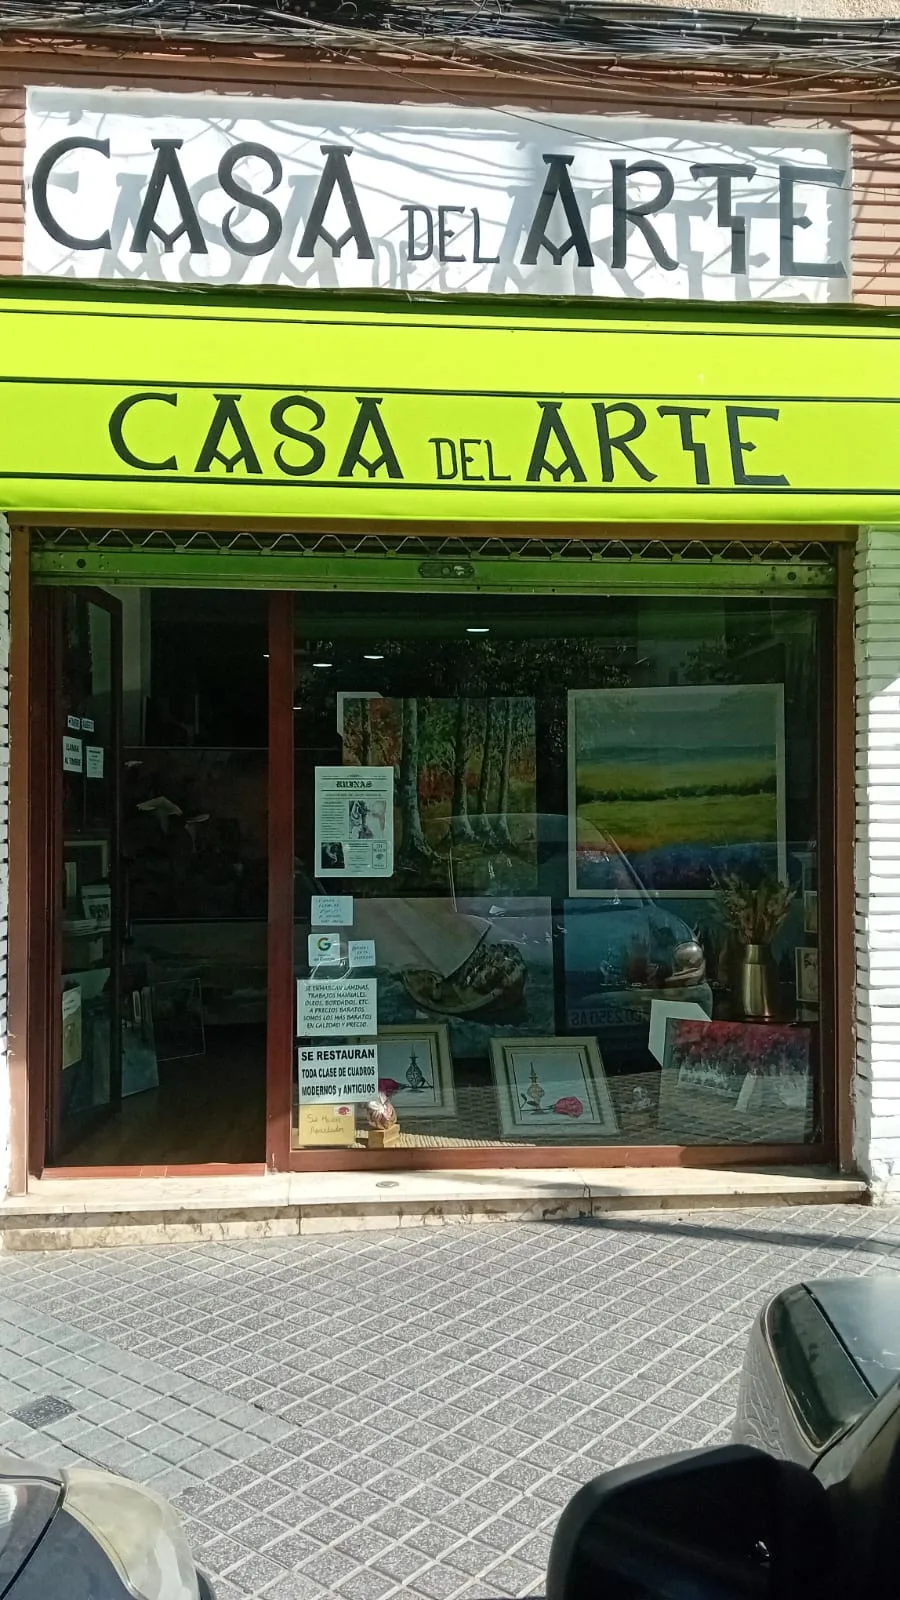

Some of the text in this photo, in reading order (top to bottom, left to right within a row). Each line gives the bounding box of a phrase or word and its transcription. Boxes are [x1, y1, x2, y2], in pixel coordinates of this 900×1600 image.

[32, 136, 848, 279] CASA DEL ARTE
[108, 392, 790, 486] CASA DEL ARTE
[301, 1049, 375, 1061] SE RESTAURAN
[301, 1066, 375, 1079] TODA CLASE DE CUADROS
[301, 1084, 337, 1096] MODERNOS
[343, 1083, 376, 1095] ANTIGUOS
